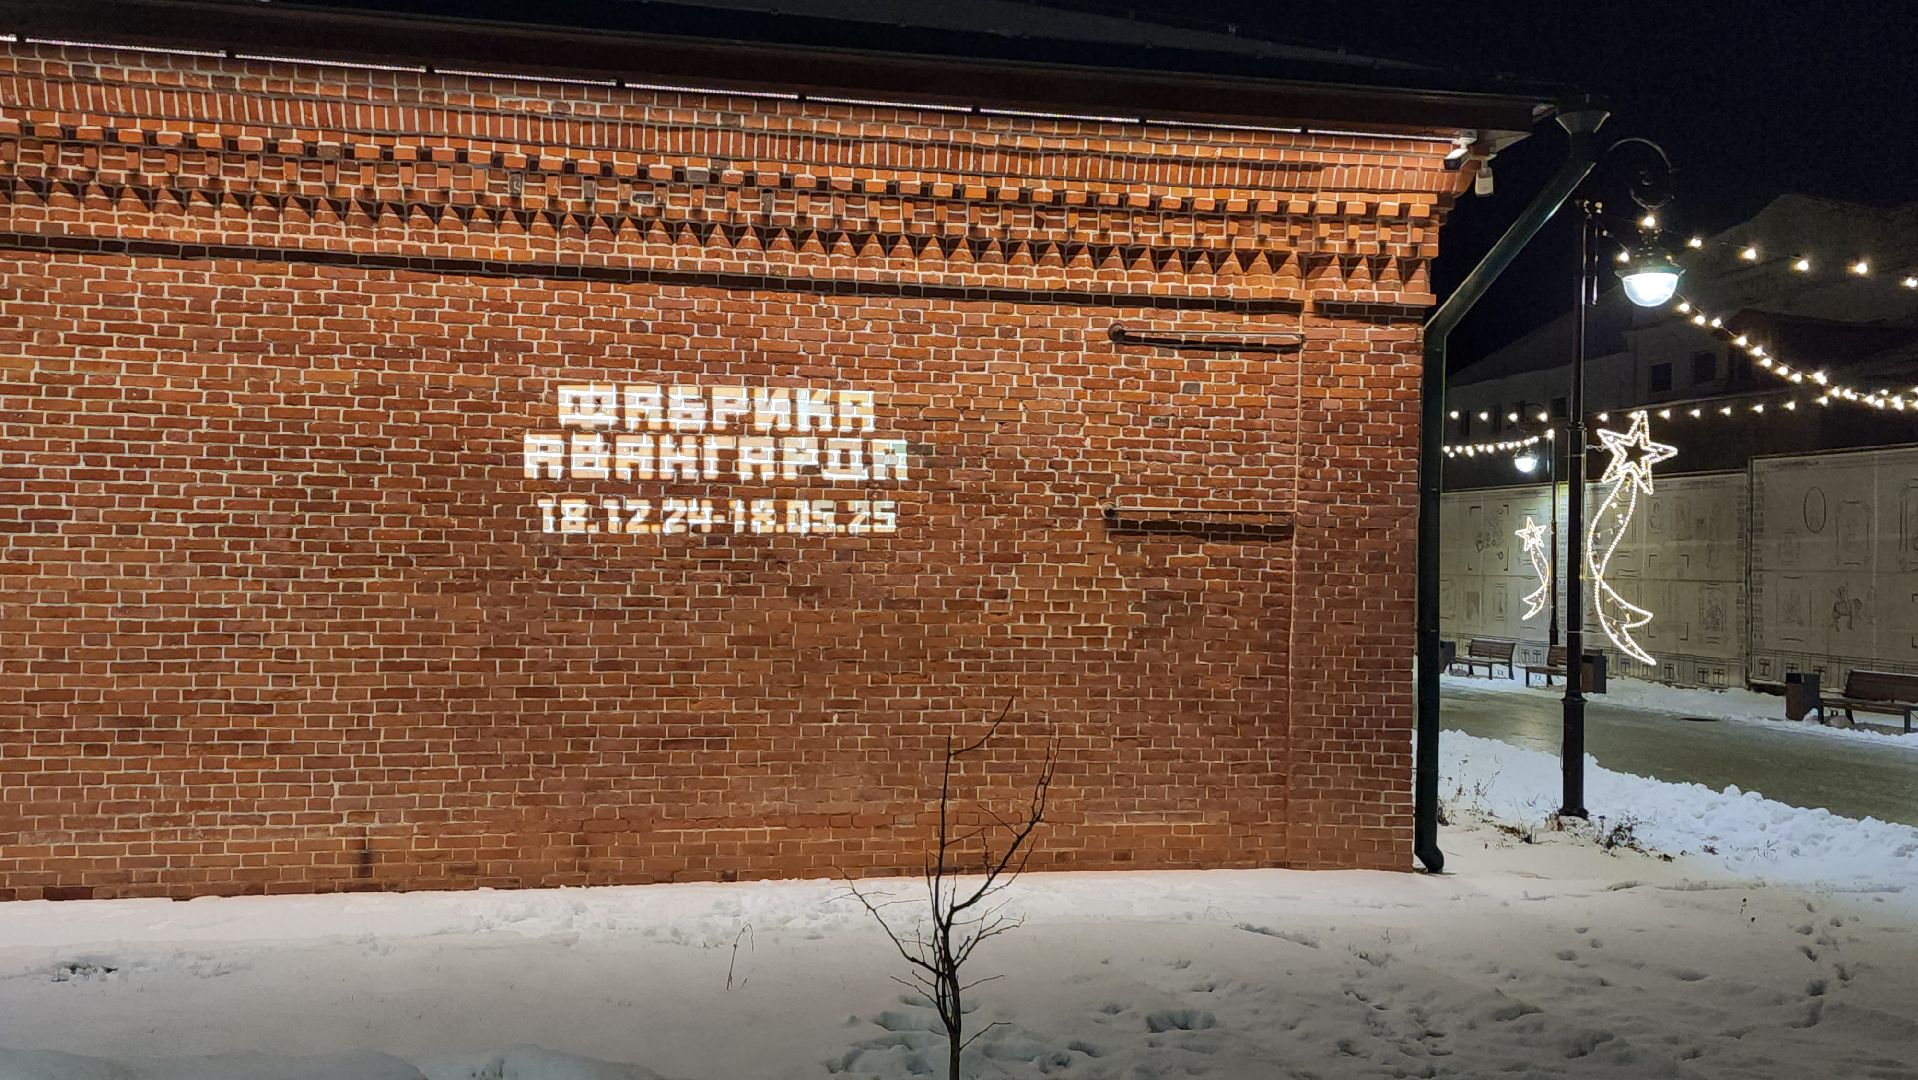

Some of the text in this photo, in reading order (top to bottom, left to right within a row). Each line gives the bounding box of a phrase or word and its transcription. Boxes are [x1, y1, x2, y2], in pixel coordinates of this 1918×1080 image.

[557, 384, 875, 432] ФАБРИКА
[523, 433, 908, 481] АВАНГАРДА
[536, 498, 898, 535] 18.12.24-18.05.25
